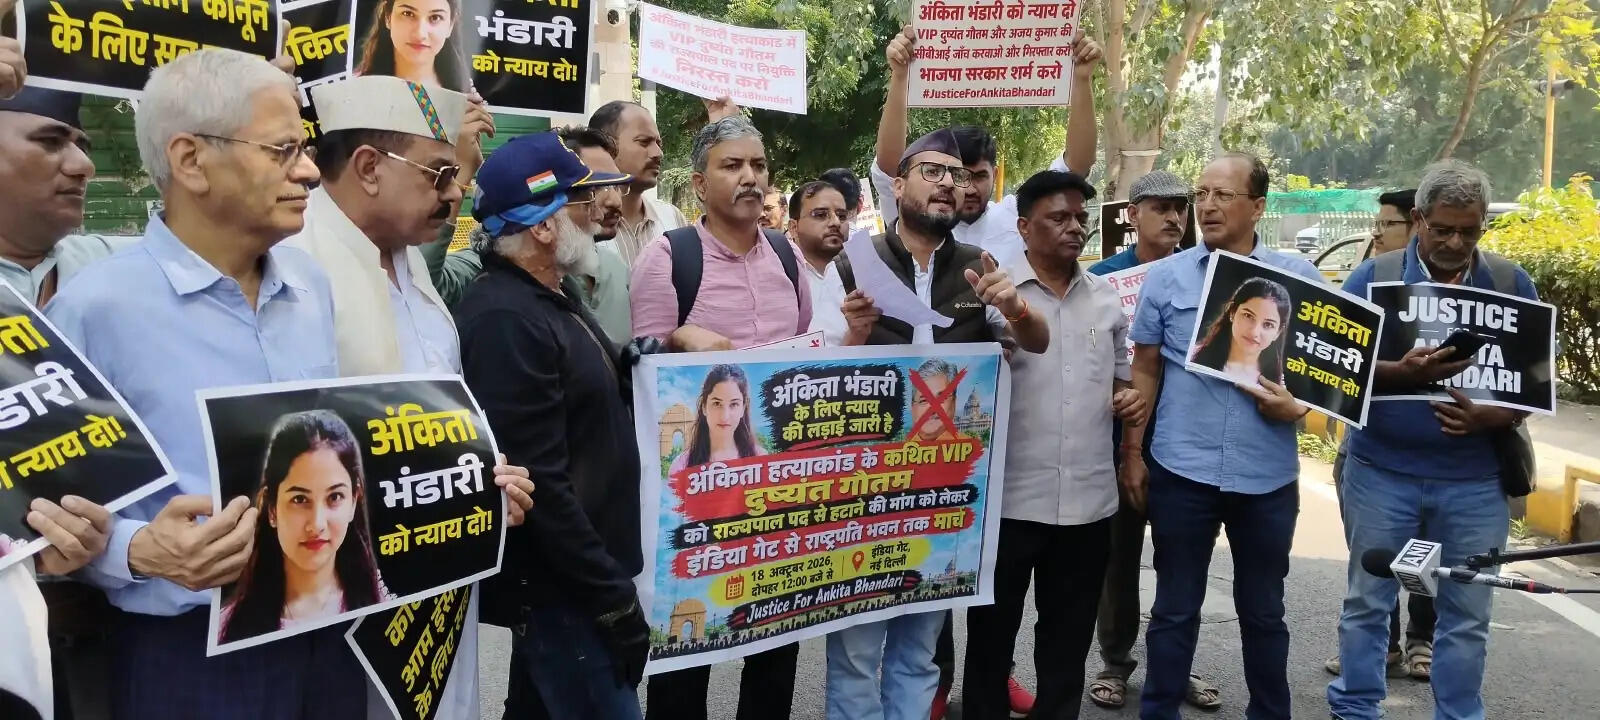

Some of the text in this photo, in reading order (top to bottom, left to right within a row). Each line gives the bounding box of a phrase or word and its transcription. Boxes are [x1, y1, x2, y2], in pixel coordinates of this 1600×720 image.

[475, 9, 577, 49] भंडारी
[919, 0, 1076, 21] अंकिता भंडारी को न्याय दो
[48, 2, 85, 54] के
[89, 11, 149, 66] लिए
[650, 12, 690, 31] अंकिता
[731, 32, 781, 48] हत्याकांड
[787, 35, 797, 48] में
[670, 33, 776, 62] VIP दुष्यंत गौतम
[917, 23, 1073, 45] VIP दुष्यंत गौतम और अजय कुमार की
[472, 50, 578, 82] को न्याय दो!
[722, 57, 736, 70] पद
[742, 61, 753, 71] पर
[758, 63, 796, 78] नियुक्ति
[914, 42, 1071, 62] सीबीआई जाँच करवाओ और गिरफ्तार करो
[676, 57, 771, 91] निरस्त करो
[920, 60, 1063, 82] भाजपा सरकार शर्म करो
[923, 86, 1056, 99] #JusticeForAnkitaBhandari
[1297, 300, 1372, 347] अंकिता
[1398, 296, 1519, 334] JUSTICE
[1295, 331, 1364, 374] भंडारी
[772, 369, 898, 408] अंकिता भंडारी
[1286, 356, 1360, 398] को न्याय दो!
[782, 412, 894, 441] की लड़ाई जारी है
[794, 398, 880, 421] के लिए न्याय
[9, 430, 87, 478] न्याय
[80, 414, 127, 449] दो!
[367, 403, 478, 456] अंकिता
[379, 453, 484, 509] भंडारी
[686, 441, 973, 495] अंकिता हत्याकांड के कथित VIP
[744, 468, 915, 517] दुष्यंत गौतम
[379, 506, 493, 557] को न्याय दो!
[684, 487, 970, 544] को राज्यपाल पद से हटाने की मांग को लेकर
[686, 506, 965, 577] इंडिया गेट से राष्ट्रपति भवन तक मार्च
[872, 541, 911, 559] इंडिया गेट,
[1402, 541, 1434, 568] ANI
[751, 556, 833, 582] 18 अक्टूबर 2026,
[869, 554, 907, 571] नई दिल्ली
[747, 571, 905, 624] Justice For Ankita Bhandari
[752, 568, 834, 598] दोपहर 12:00 बजे से
[1399, 571, 1426, 595] ANI
[401, 622, 434, 693] आम
[414, 681, 432, 720] के
